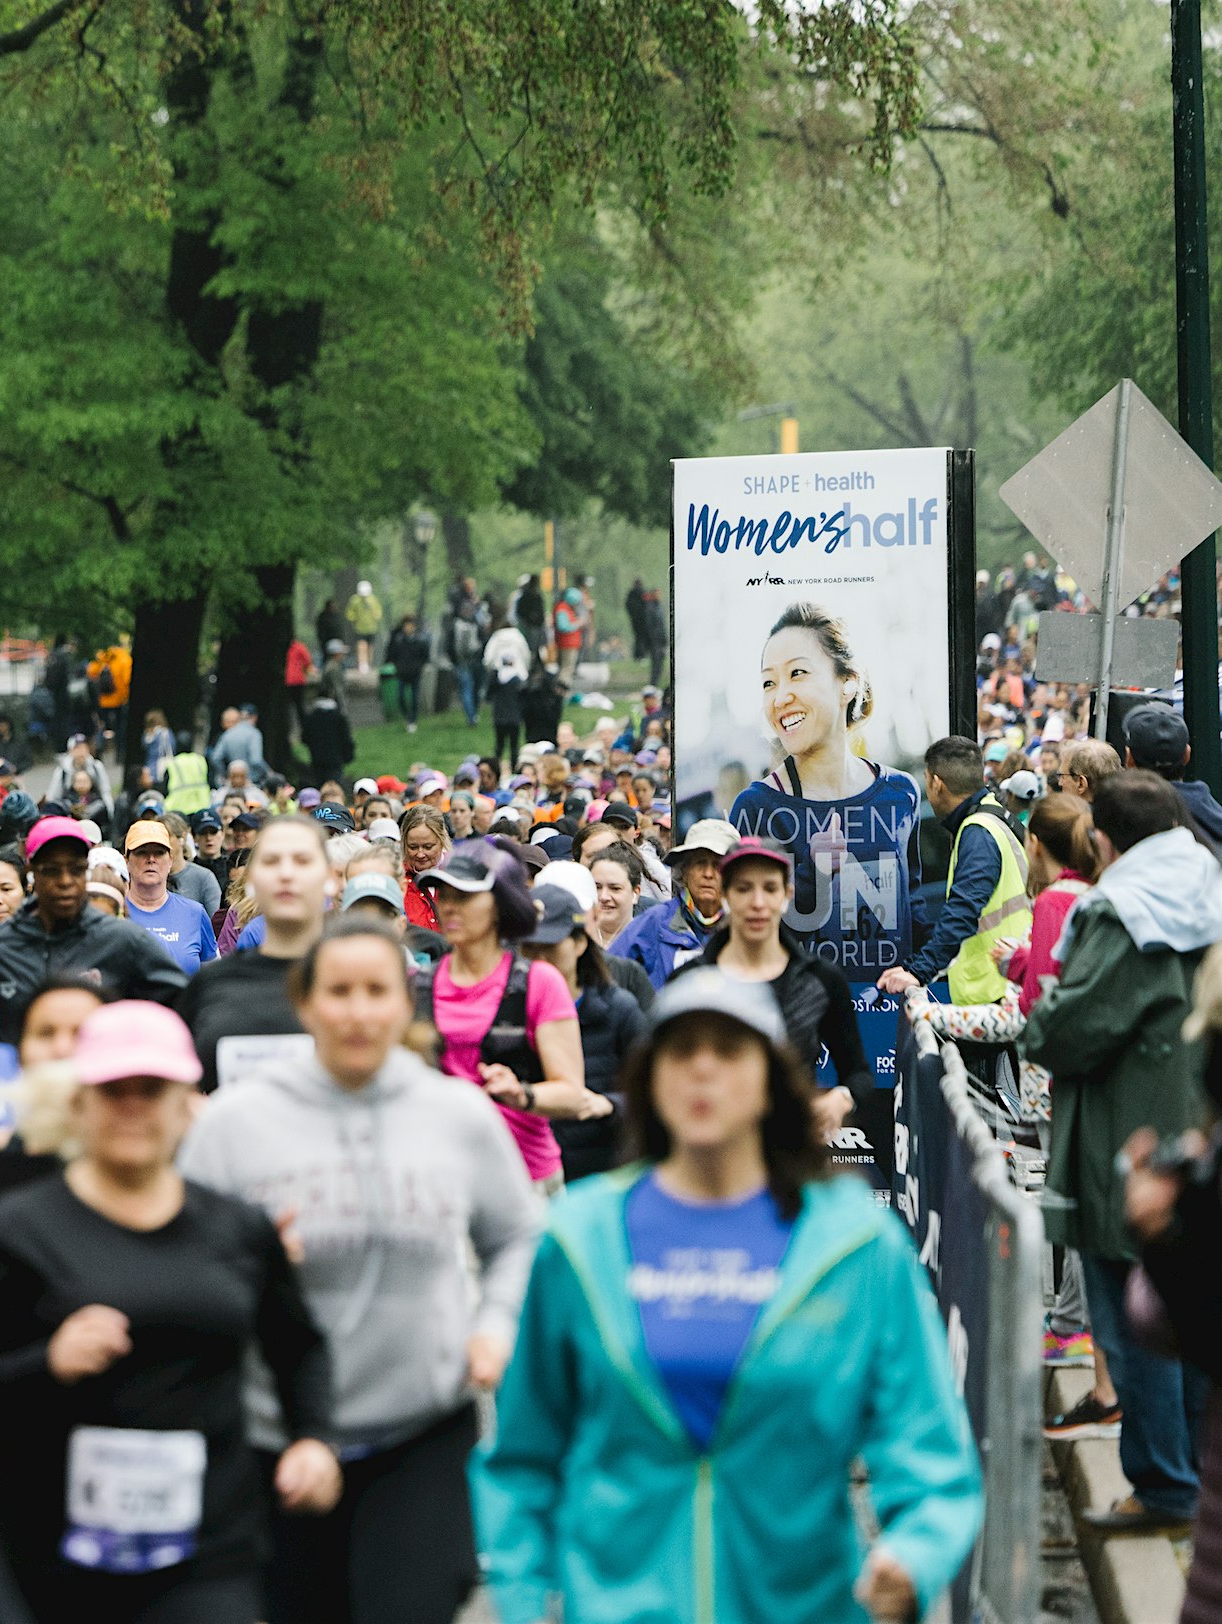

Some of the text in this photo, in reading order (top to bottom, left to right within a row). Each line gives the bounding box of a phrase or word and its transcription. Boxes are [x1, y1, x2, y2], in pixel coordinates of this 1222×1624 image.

[743, 474, 800, 494] SHAPE
[814, 471, 875, 492] health
[687, 498, 937, 556] Women's half
[723, 805, 897, 845] WOMEN
[841, 903, 887, 940] 562
[832, 1155, 875, 1164] RUNNERS
